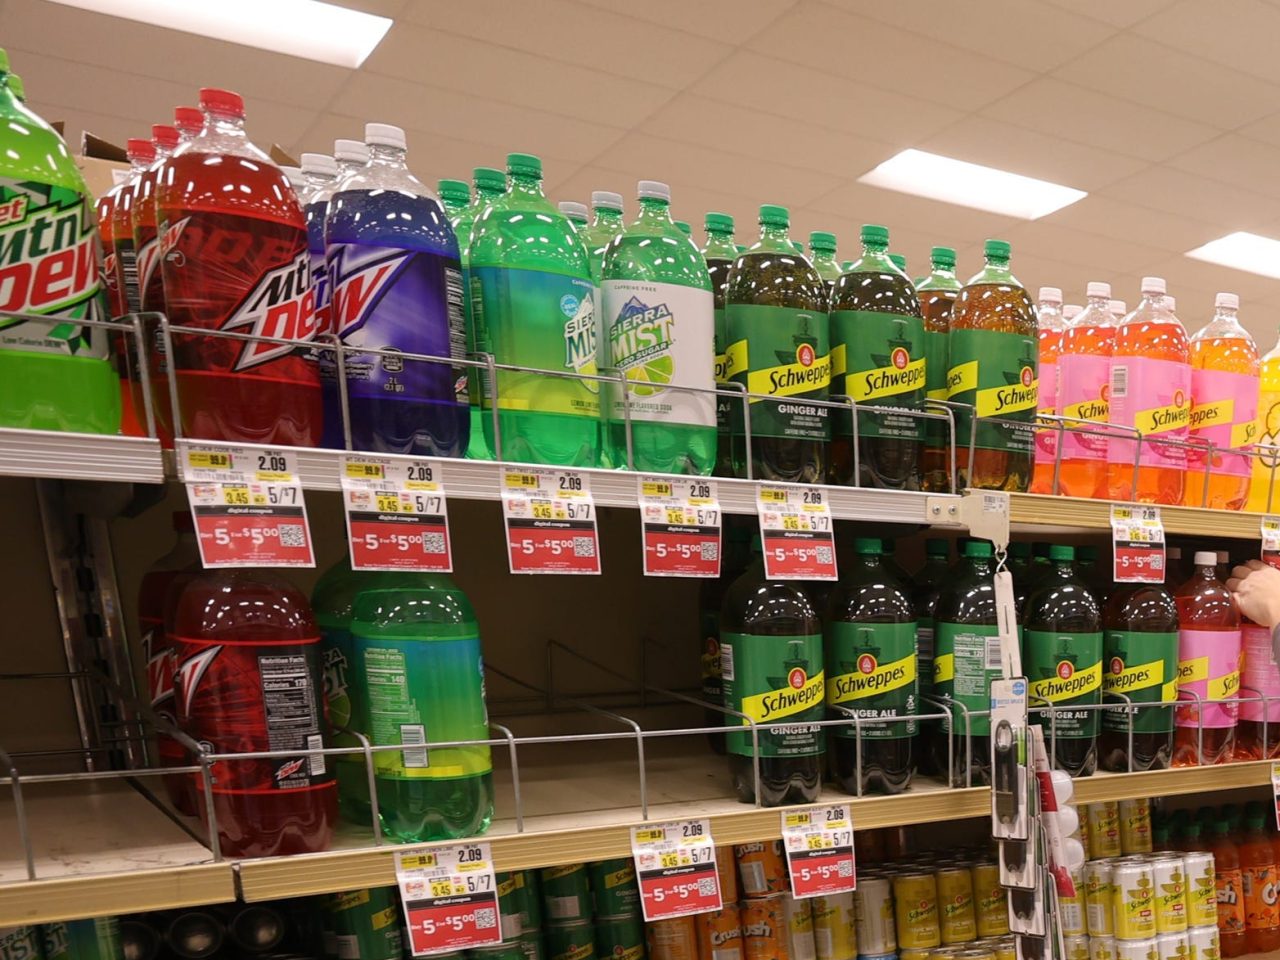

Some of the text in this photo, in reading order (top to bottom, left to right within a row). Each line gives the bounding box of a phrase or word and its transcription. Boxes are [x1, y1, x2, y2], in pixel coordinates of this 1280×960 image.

[610, 306, 668, 337] SIERRA
[612, 315, 674, 361] MIST
[636, 343, 667, 360] SUGAR
[778, 405, 828, 417] GINGER ALE
[258, 456, 286, 471] 2.09
[407, 467, 432, 481] 2.09
[560, 477, 582, 490] 2.09
[226, 492, 249, 504] 3.45
[690, 485, 710, 498] 2.09
[804, 492, 822, 504] 2.09
[379, 500, 398, 512] 3.45
[534, 507, 551, 518] 3.45
[215, 528, 230, 545] 5
[366, 534, 379, 549] 5
[522, 540, 534, 554] 5
[656, 544, 667, 557] 5
[775, 548, 786, 561] 5
[1122, 556, 1129, 567] 5
[836, 665, 905, 699] Schweppes
[1034, 670, 1096, 698] Schweppes
[880, 709, 896, 718] ALE
[1073, 710, 1088, 719] ALE
[826, 809, 844, 821] 2.09
[683, 824, 702, 837] 2.09
[458, 849, 482, 863] 2.09
[801, 868, 811, 881] 5
[432, 885, 451, 896] 3.45
[653, 888, 665, 901] 5
[423, 920, 436, 935] 5
